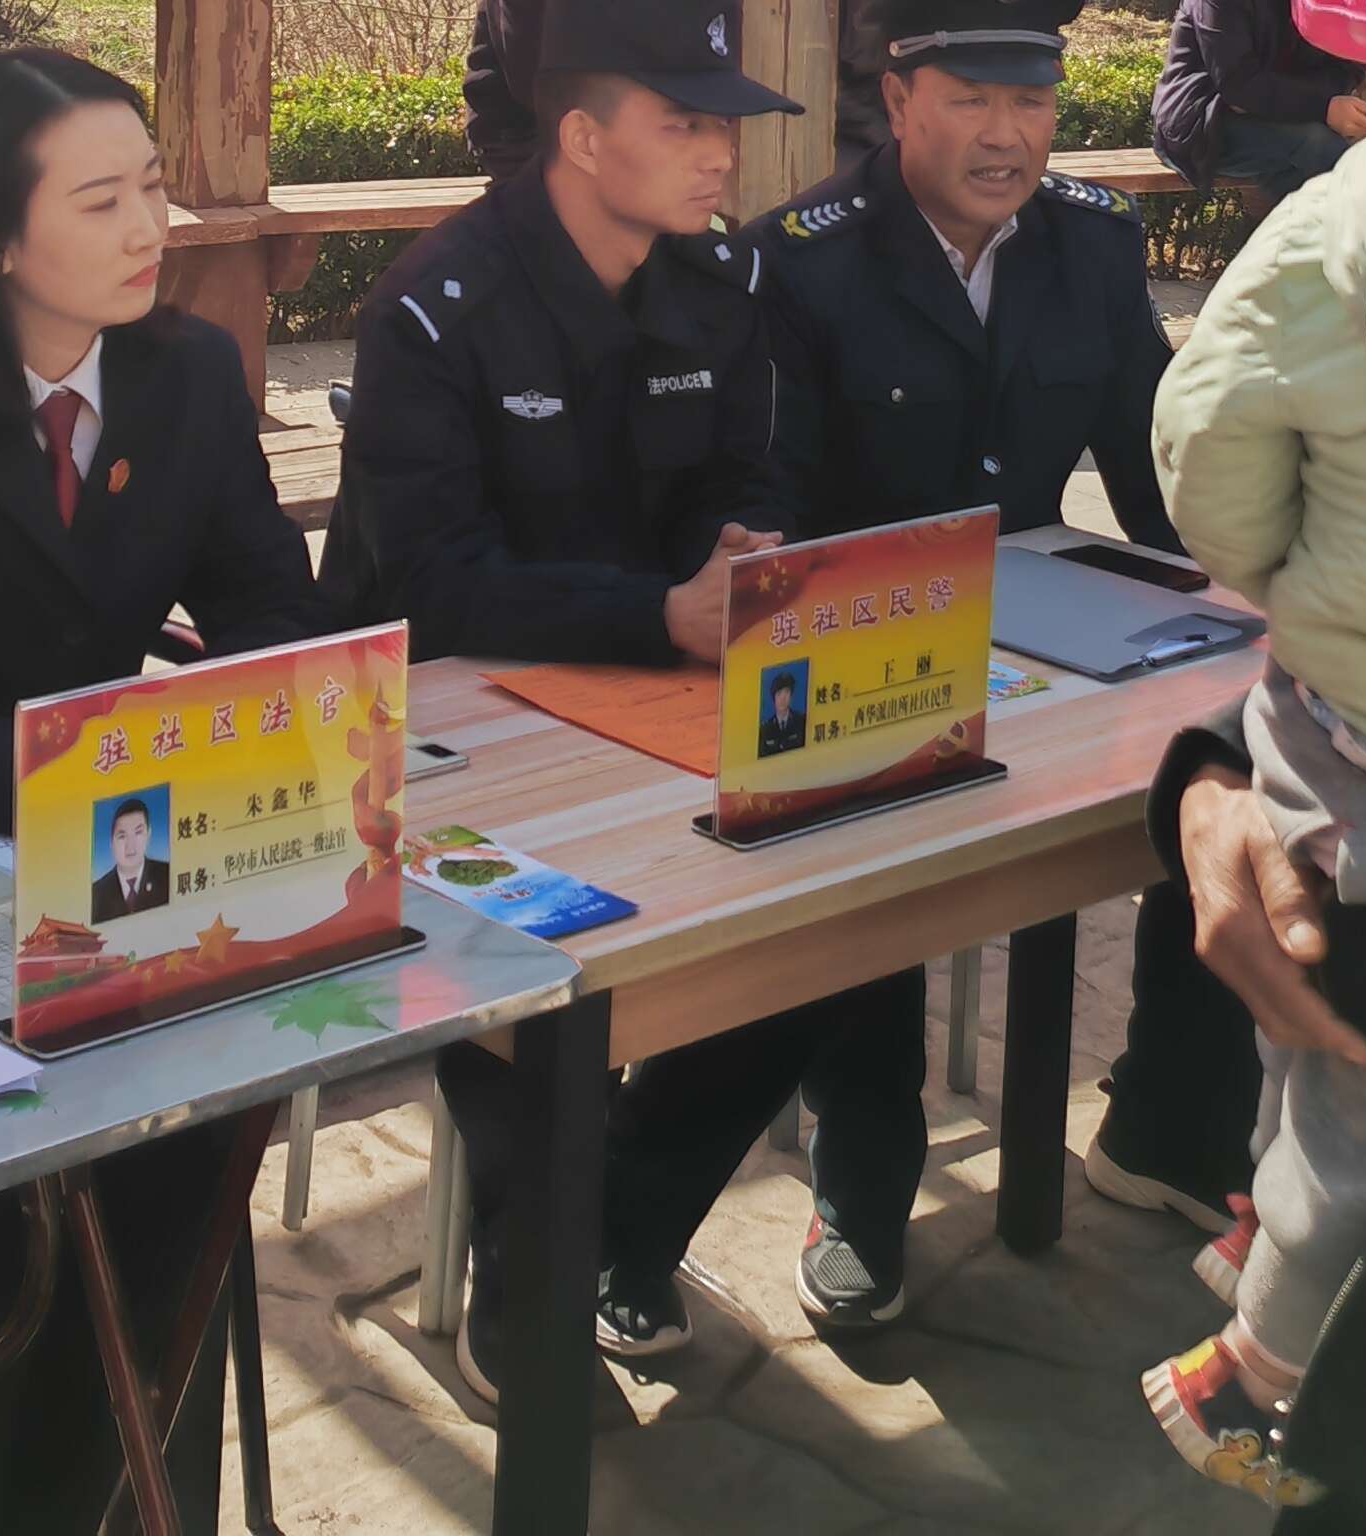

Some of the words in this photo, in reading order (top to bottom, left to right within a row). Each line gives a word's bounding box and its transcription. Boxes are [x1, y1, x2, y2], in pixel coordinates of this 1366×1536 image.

[770, 576, 955, 647] 驻社区民警
[92, 675, 348, 776] 驻社区法官
